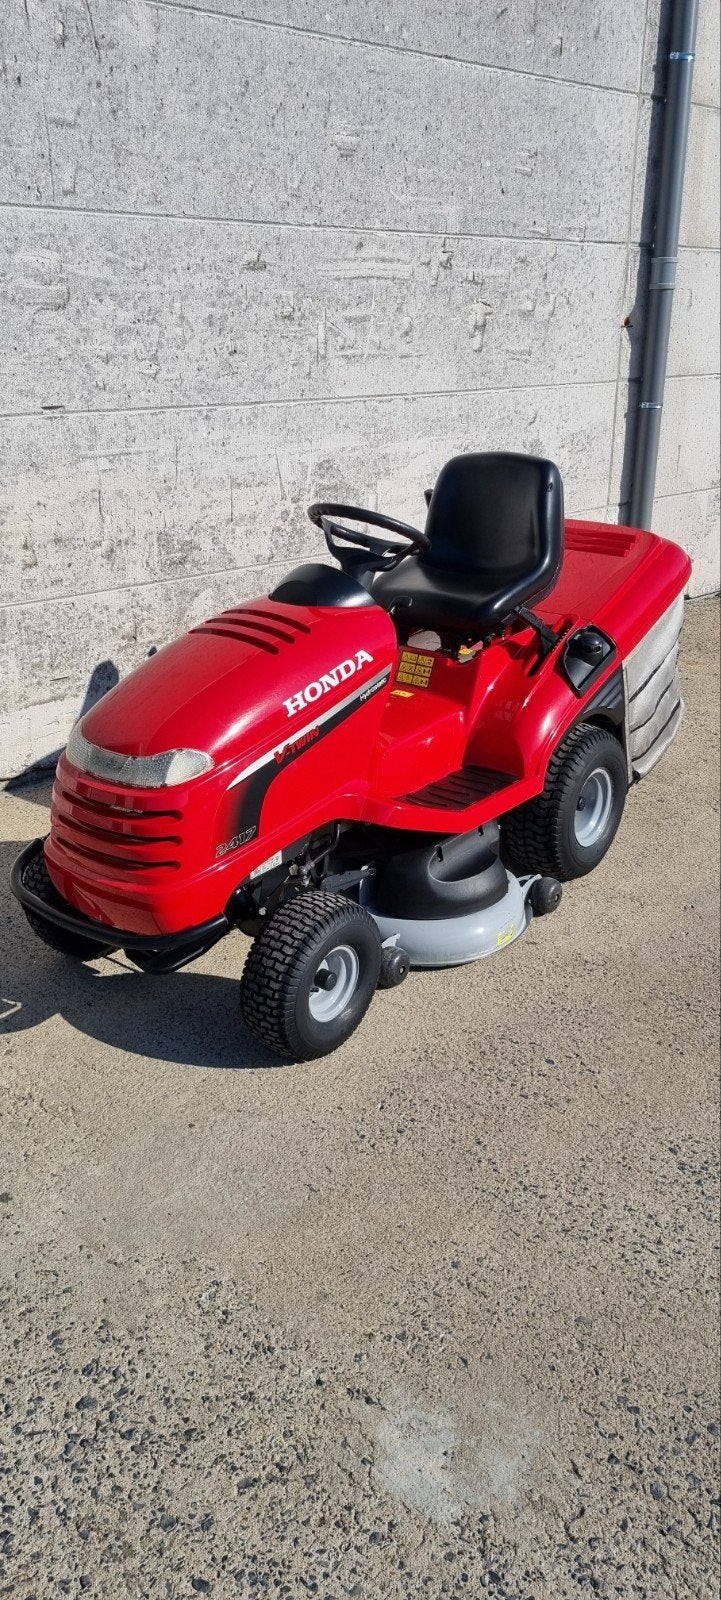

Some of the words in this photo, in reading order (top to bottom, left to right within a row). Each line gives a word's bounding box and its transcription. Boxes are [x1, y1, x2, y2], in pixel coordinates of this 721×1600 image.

[282, 649, 374, 718] HONDA
[273, 725, 321, 764] V-TWIN
[215, 825, 257, 859] 2417
